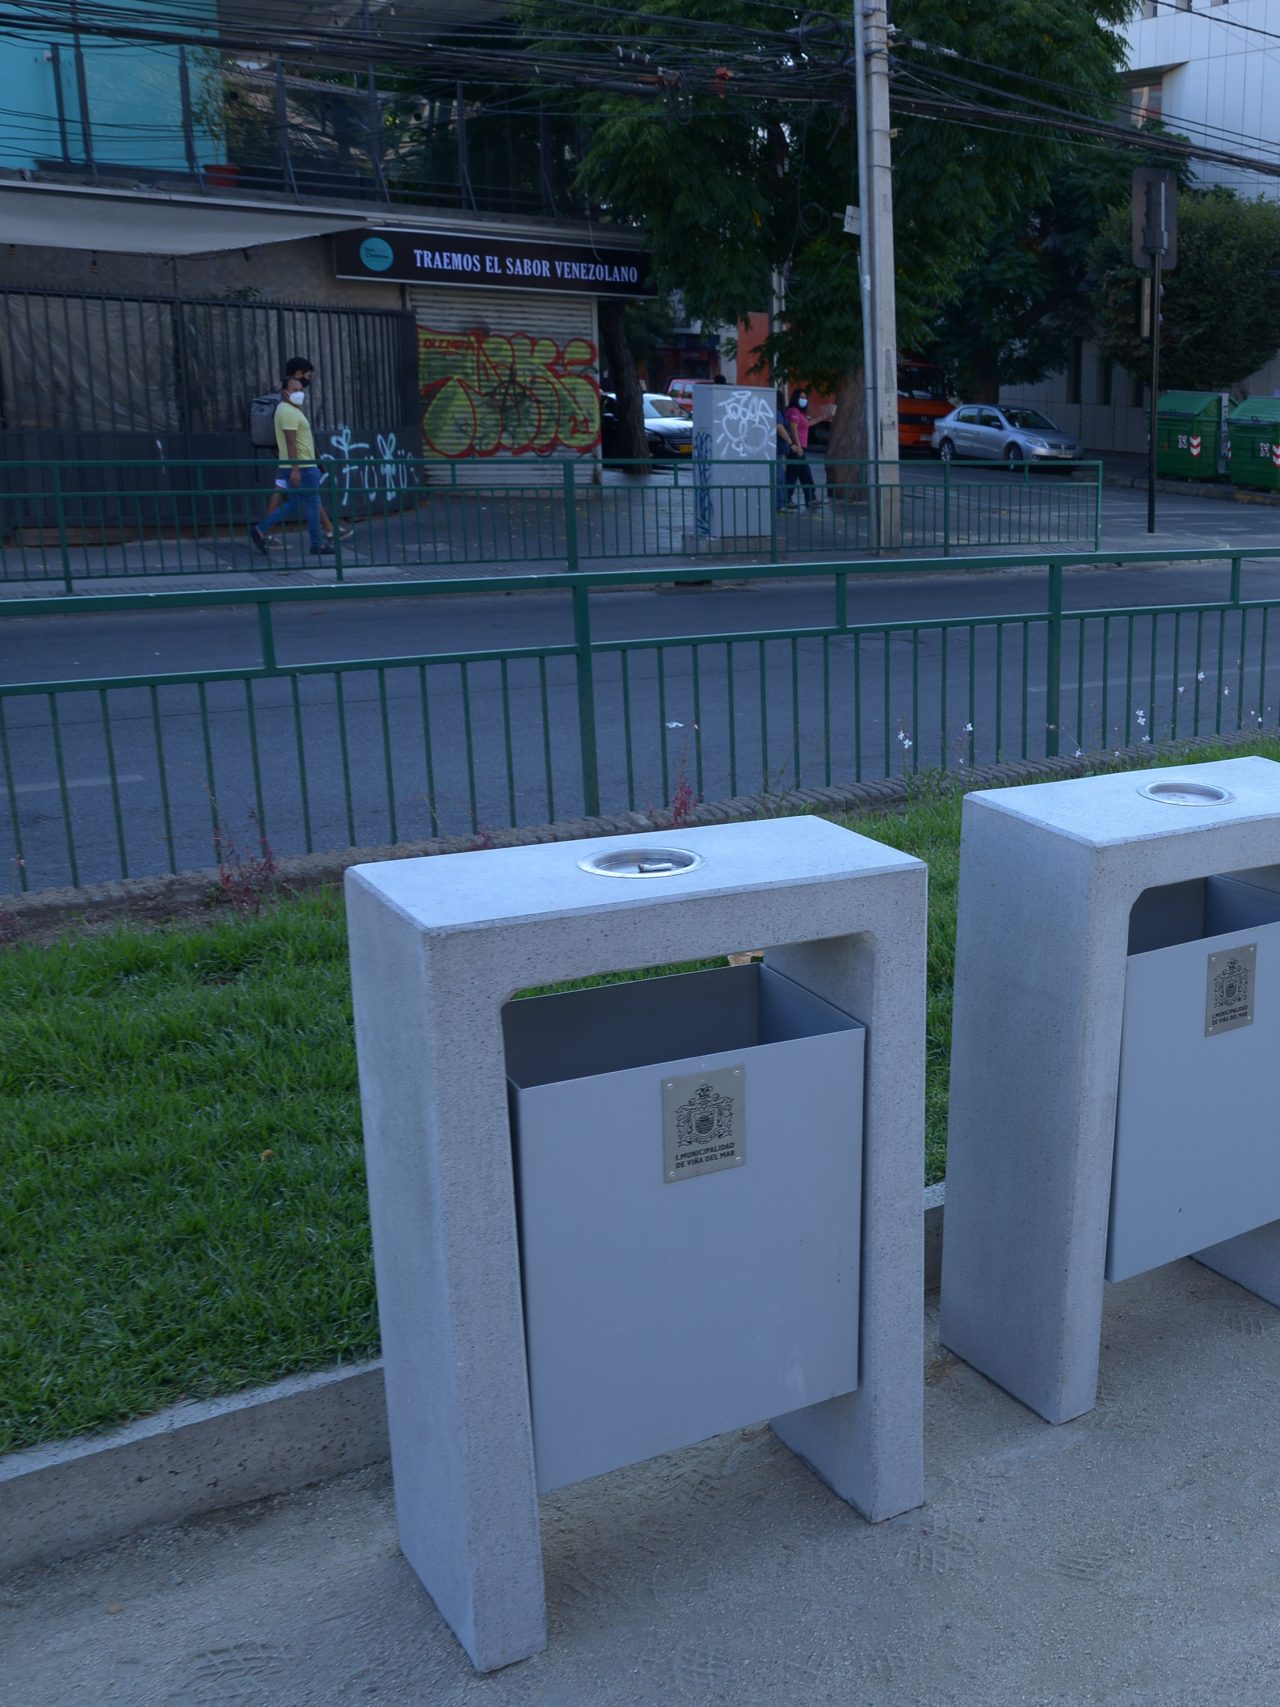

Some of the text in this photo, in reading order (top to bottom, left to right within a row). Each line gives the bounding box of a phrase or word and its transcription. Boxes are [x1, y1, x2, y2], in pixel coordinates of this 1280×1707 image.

[413, 249, 639, 284] TRAEMOS EL SABOR VENEZOLANO
[705, 1154, 719, 1162] DEL
[720, 1150, 735, 1158] MAR
